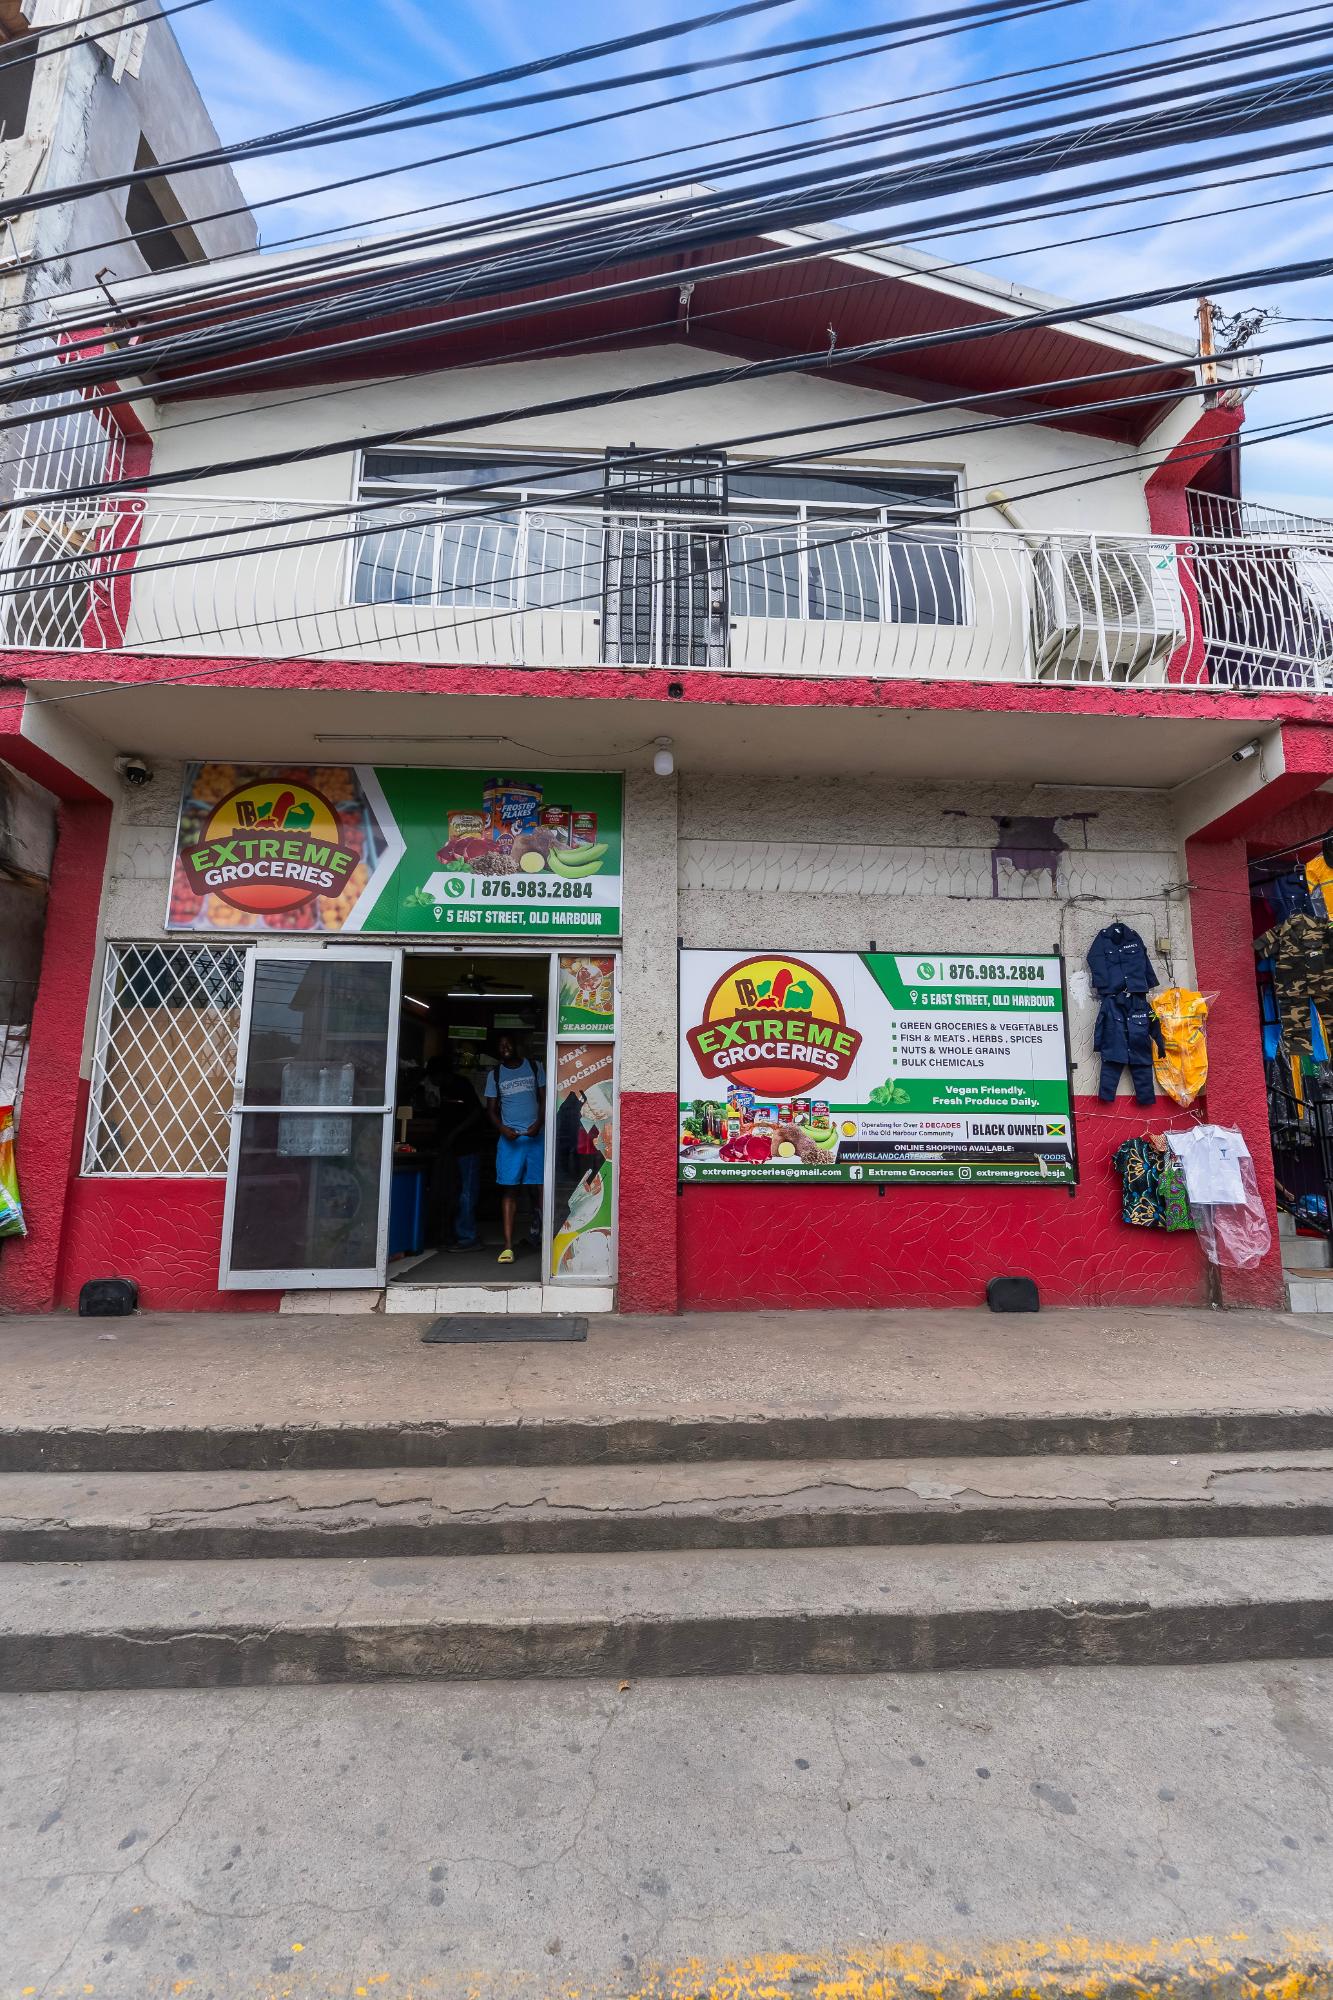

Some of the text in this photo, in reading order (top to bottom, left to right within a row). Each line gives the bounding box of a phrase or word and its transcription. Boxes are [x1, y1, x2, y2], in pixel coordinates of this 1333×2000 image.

[502, 802, 536, 812] FROSTED
[502, 810, 532, 819] FLAKES
[190, 839, 353, 875] EXTREME
[204, 861, 335, 888] GROCERIES
[481, 881, 593, 899] 876.983.2884
[446, 910, 602, 925] 5 EAST STREET, OLD HARBOUR
[949, 964, 1045, 981] 876.983.2884
[921, 994, 1055, 1007] 5 EAST STREET, OLD HARBOUR
[900, 1022, 1059, 1032] GREEN GROCERIES & VEGETABLES
[697, 1019, 856, 1056] EXTREME
[900, 1034, 922, 1042] FISH
[933, 1035, 966, 1043] MEATS
[972, 1035, 1003, 1043] HERBS
[1010, 1036, 1043, 1044] SPICES
[559, 1045, 588, 1066] MEAT
[901, 1046, 927, 1054] NUTS
[938, 1047, 973, 1055] WHOLE
[975, 1047, 1011, 1055] GRAINS
[713, 1043, 840, 1070] GROCERIES
[575, 1061, 583, 1069] &
[901, 1059, 985, 1067] BULK CHEMICALS
[558, 1056, 613, 1091] GROCERIES
[945, 1085, 1026, 1096] Vegan Friendly.
[932, 1097, 1040, 1108] Fresh Produce Daily.
[973, 1124, 1044, 1136] BLACK OWNED
[702, 1168, 842, 1177] extremegroceries@gmail.com
[976, 1169, 1066, 1178] extremegroceesja
